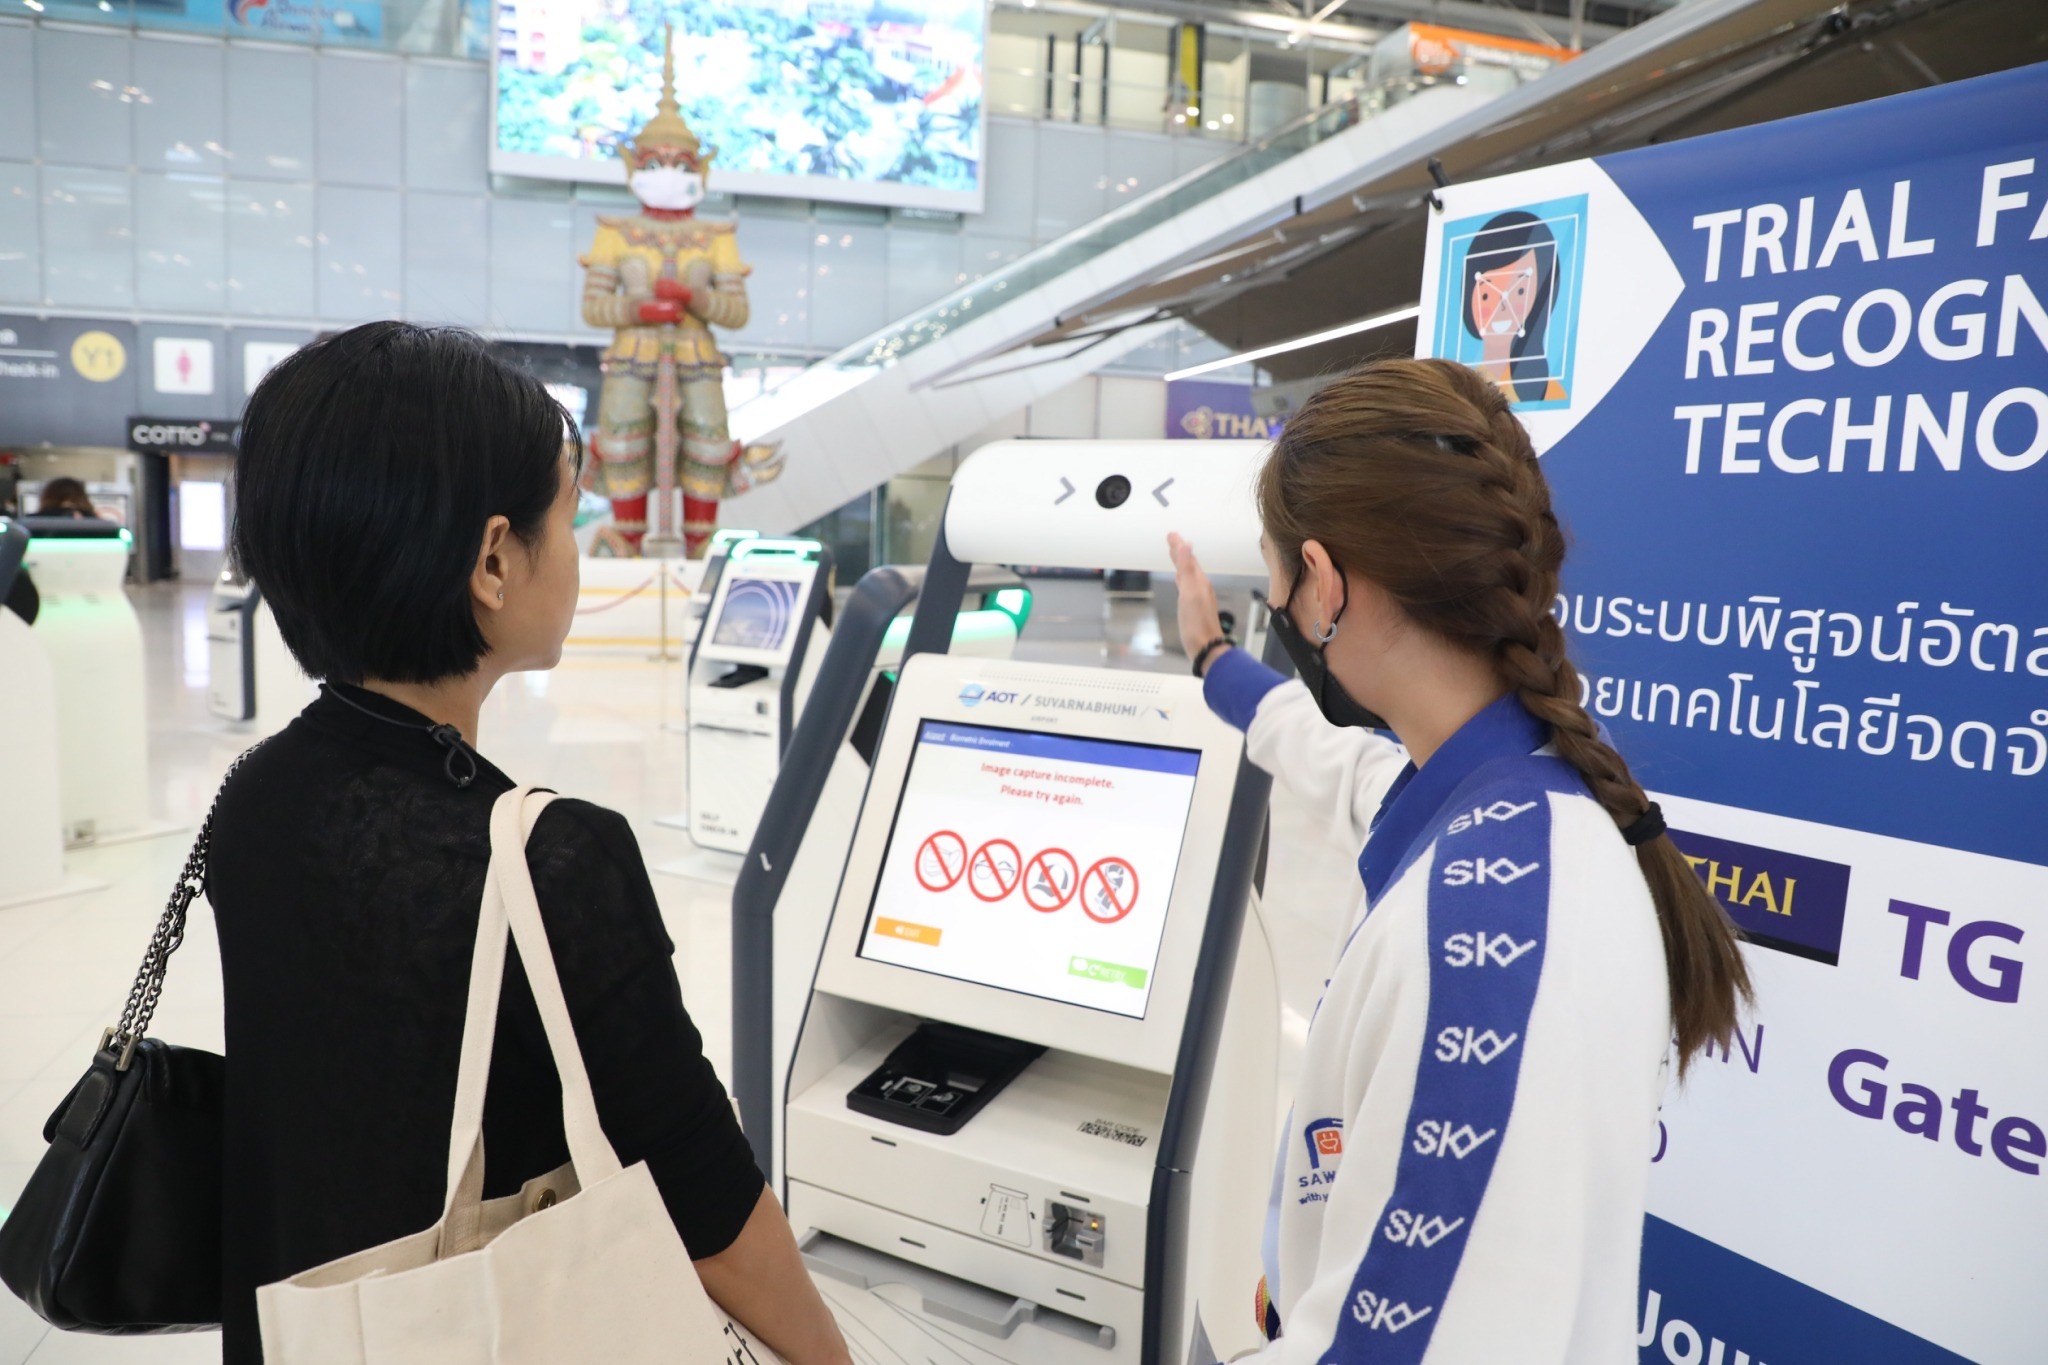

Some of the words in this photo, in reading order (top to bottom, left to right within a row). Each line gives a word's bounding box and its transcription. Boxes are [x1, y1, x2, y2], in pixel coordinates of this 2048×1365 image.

[1692, 180, 1935, 283] TRIAL
[1685, 274, 2048, 379] RECOGN
[132, 424, 207, 447] COTTO
[1673, 387, 2048, 475] TECHNO
[986, 690, 1018, 704] AOT
[1034, 695, 1137, 716] SUVARNABHUMI
[981, 762, 1011, 777] Image
[1013, 768, 1051, 782] capture
[1054, 772, 1114, 789] incomplete.
[1000, 784, 1033, 799] Please
[1036, 789, 1051, 802] try
[1053, 793, 1083, 806] again.
[1446, 800, 1537, 836] SKY
[1443, 856, 1540, 886] SKY
[1444, 931, 1537, 968] SKY
[1888, 898, 2025, 1004] TG
[1435, 1026, 1518, 1065] SKY
[1827, 1048, 2047, 1176] Gate
[1413, 1120, 1496, 1159] SKY
[1384, 1208, 1465, 1248] SKY
[1352, 1290, 1432, 1333] SKY
